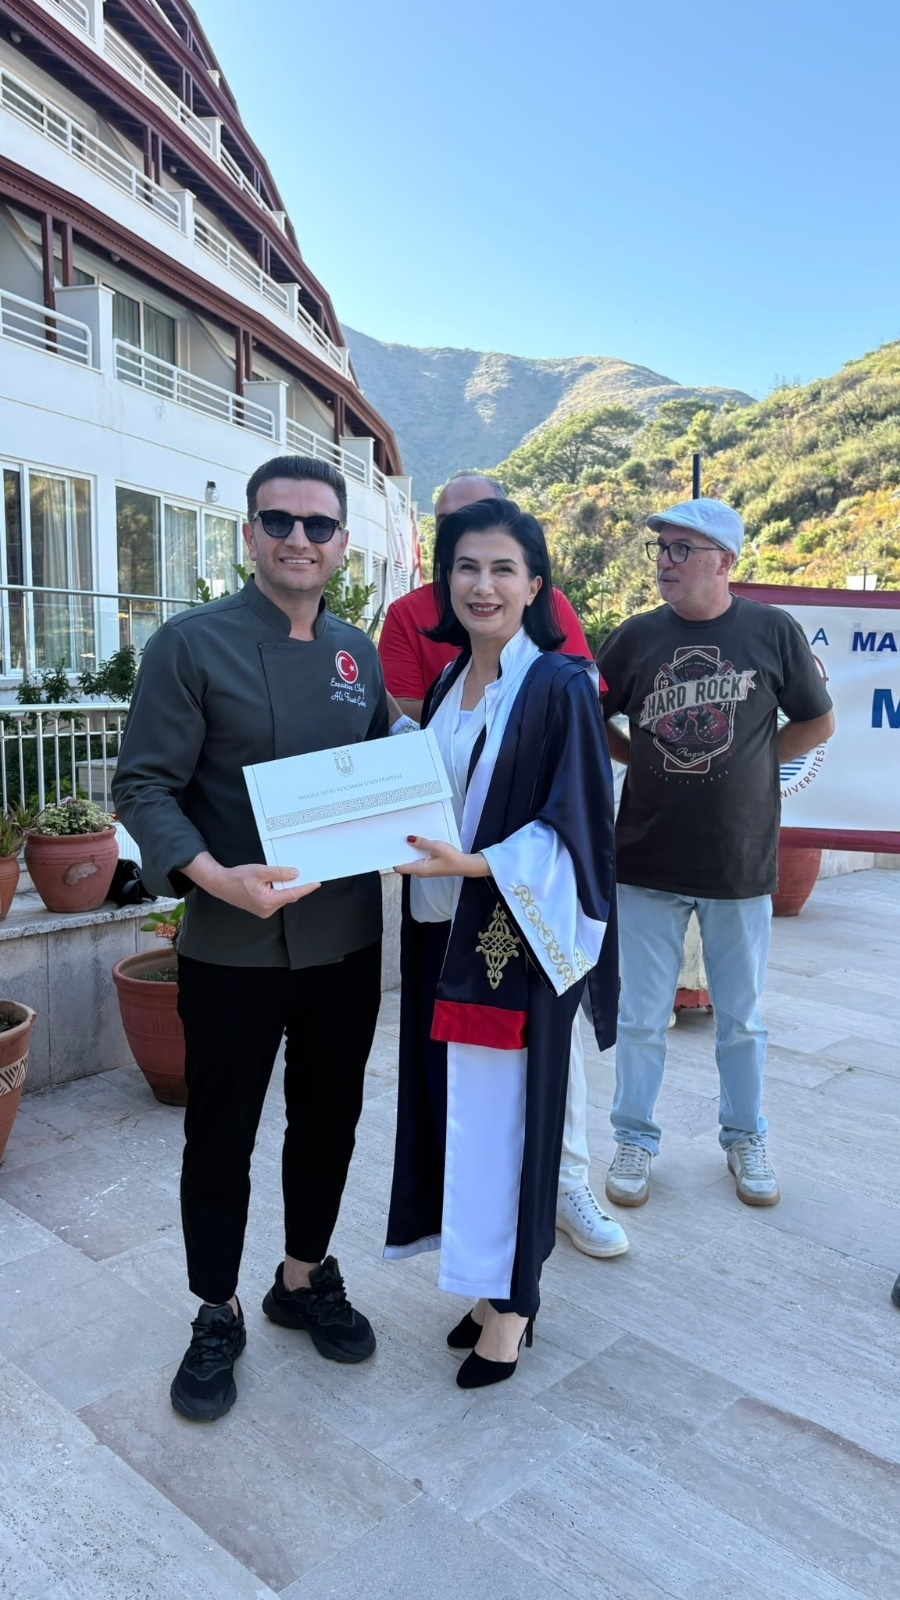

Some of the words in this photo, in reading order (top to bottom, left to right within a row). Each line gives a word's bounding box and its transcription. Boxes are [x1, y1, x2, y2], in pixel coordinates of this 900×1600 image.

[852, 631, 900, 652] MA
[660, 679, 669, 689] 19
[647, 685, 687, 719] HARD
[695, 676, 742, 704] ROCK
[676, 747, 706, 761] Prague
[780, 744, 826, 799] NİVERSİTESİ
